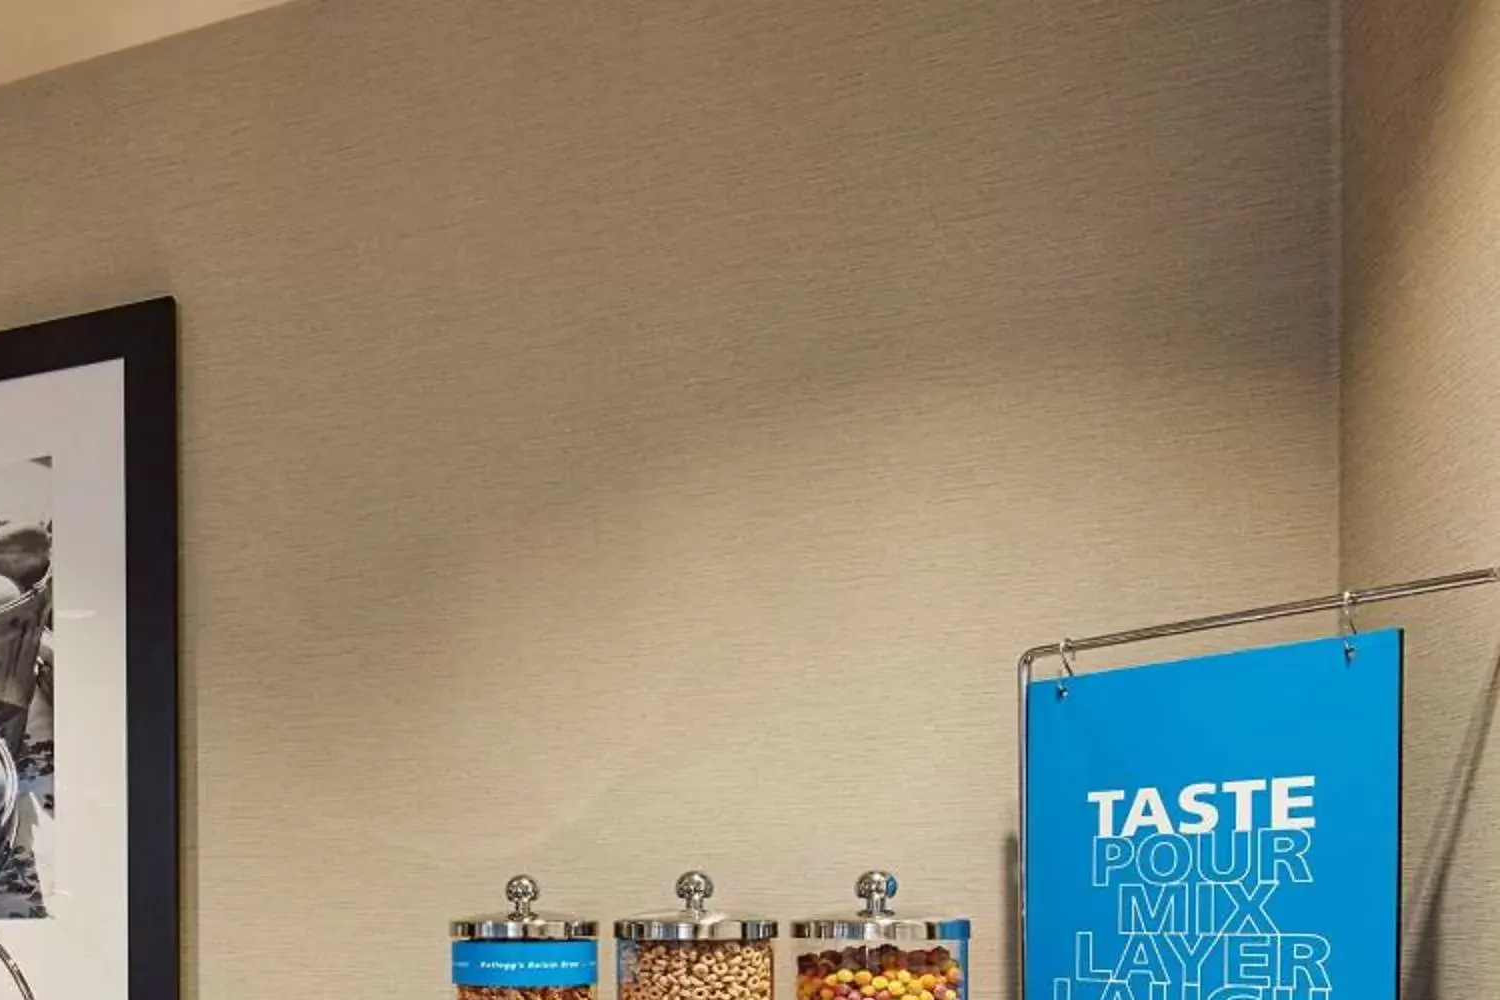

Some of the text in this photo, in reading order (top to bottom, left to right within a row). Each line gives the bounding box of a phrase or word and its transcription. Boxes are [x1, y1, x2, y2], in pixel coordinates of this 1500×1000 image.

[1087, 775, 1316, 838] TASTE
[1092, 827, 1314, 887] POUR
[1118, 880, 1280, 937] MIX
[1075, 931, 1333, 991] LAYER
